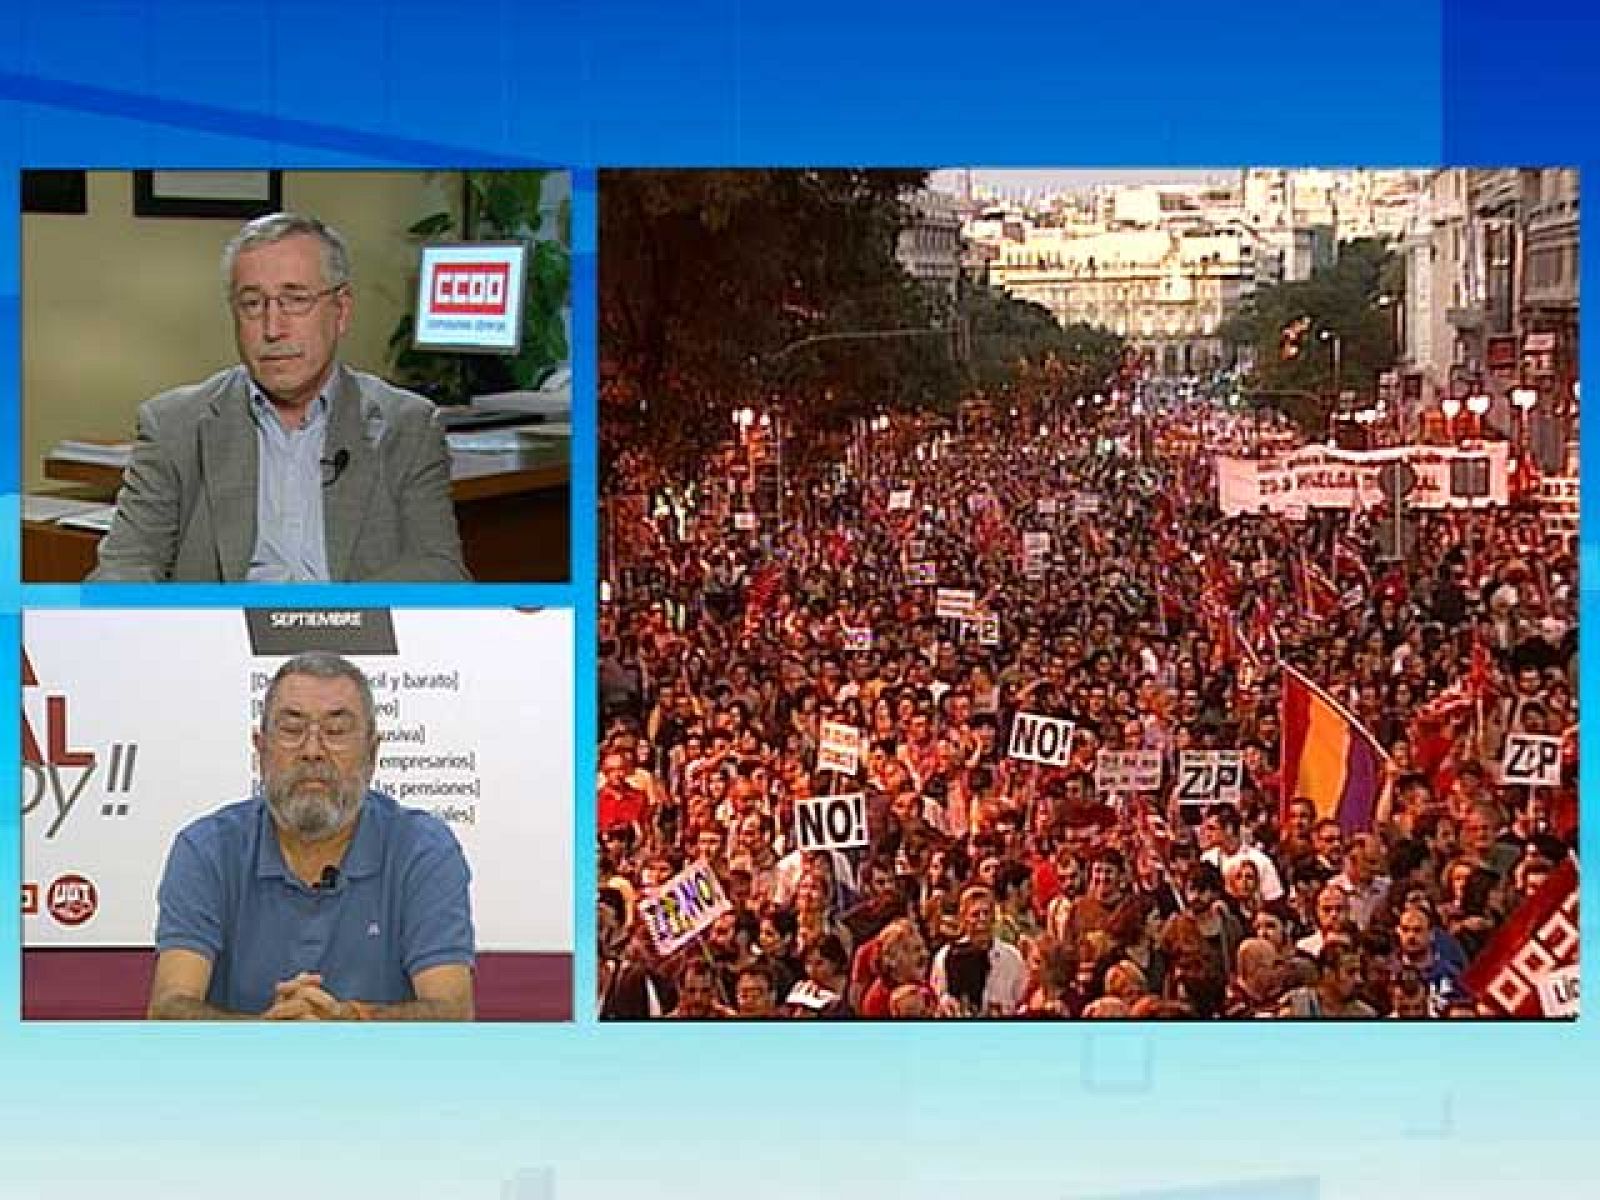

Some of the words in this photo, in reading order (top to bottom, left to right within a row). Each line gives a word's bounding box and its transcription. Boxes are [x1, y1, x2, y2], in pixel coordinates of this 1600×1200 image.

[436, 271, 505, 304] CCOO
[269, 611, 361, 627] SEPTIEMBRE
[390, 676, 400, 691] y
[402, 670, 459, 691] barato]
[1014, 716, 1071, 762] NO!
[379, 751, 475, 771] empresarios]
[399, 779, 480, 798] pensiones]
[798, 797, 865, 846] NO!
